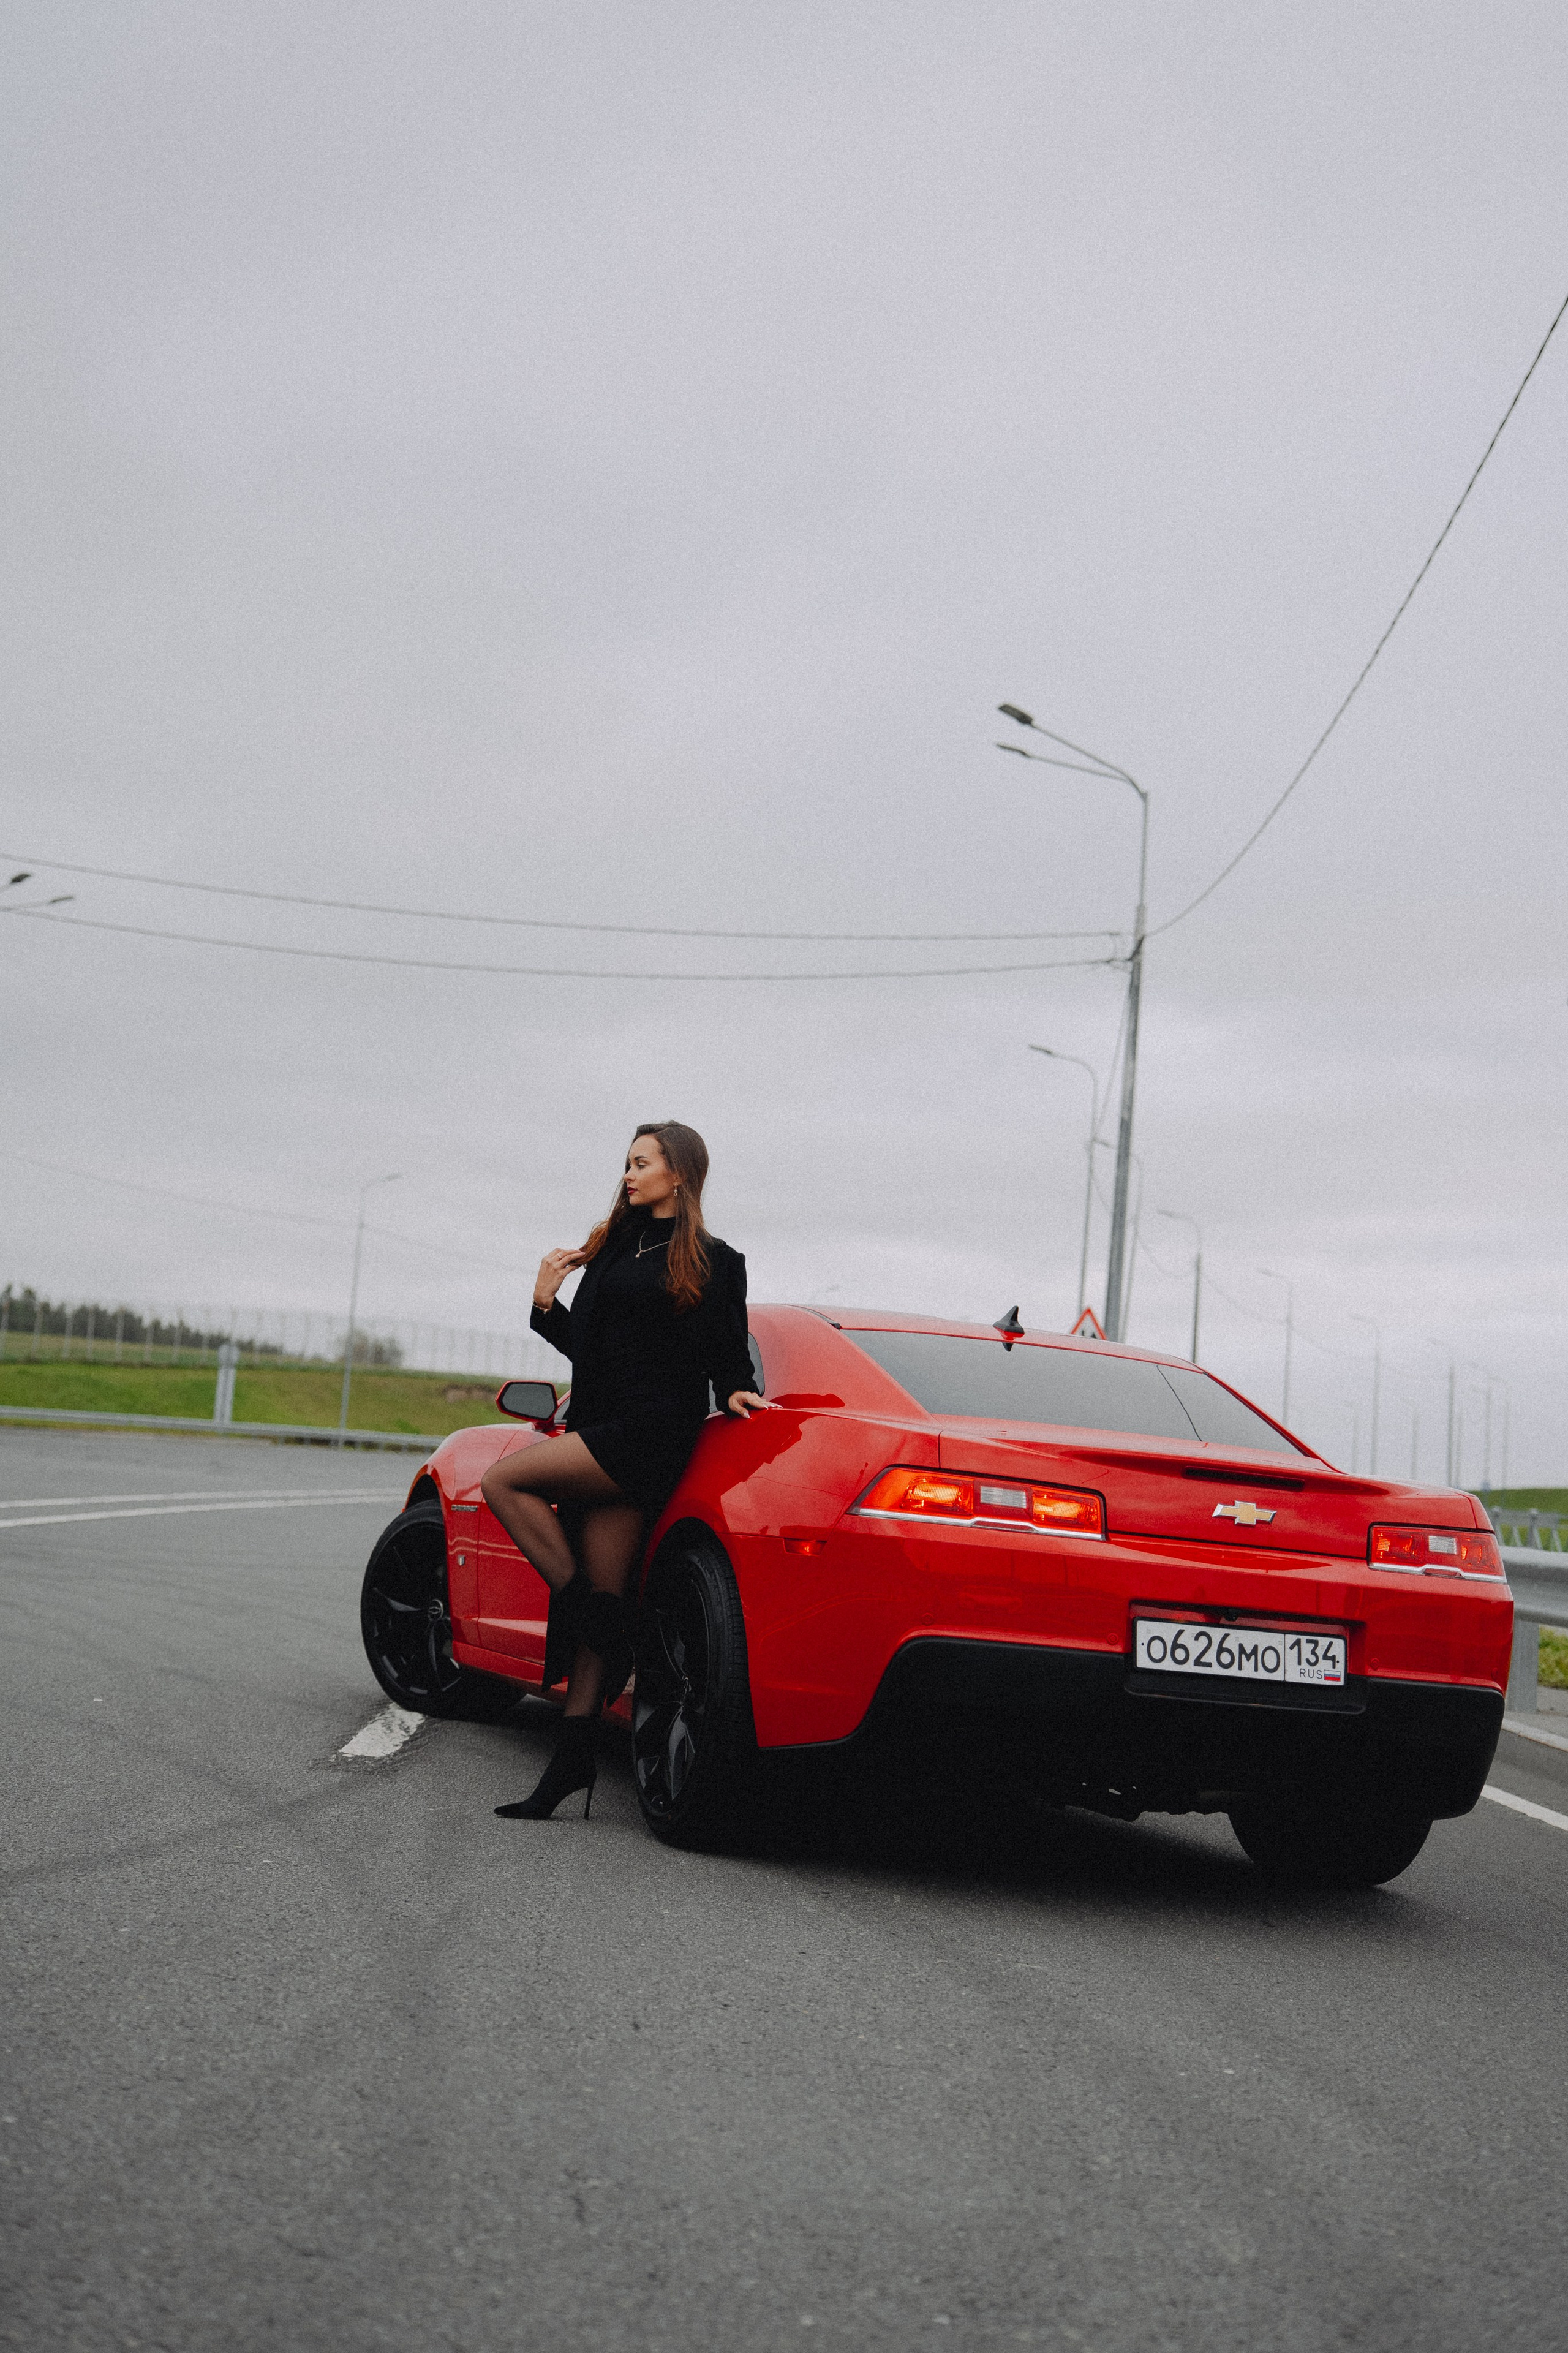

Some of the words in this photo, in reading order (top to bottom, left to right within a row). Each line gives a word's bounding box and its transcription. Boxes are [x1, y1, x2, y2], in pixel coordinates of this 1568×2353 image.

[1147, 1629, 1280, 1673] O626MO
[1289, 1638, 1336, 1669] 134
[1300, 1668, 1322, 1679] RUS
